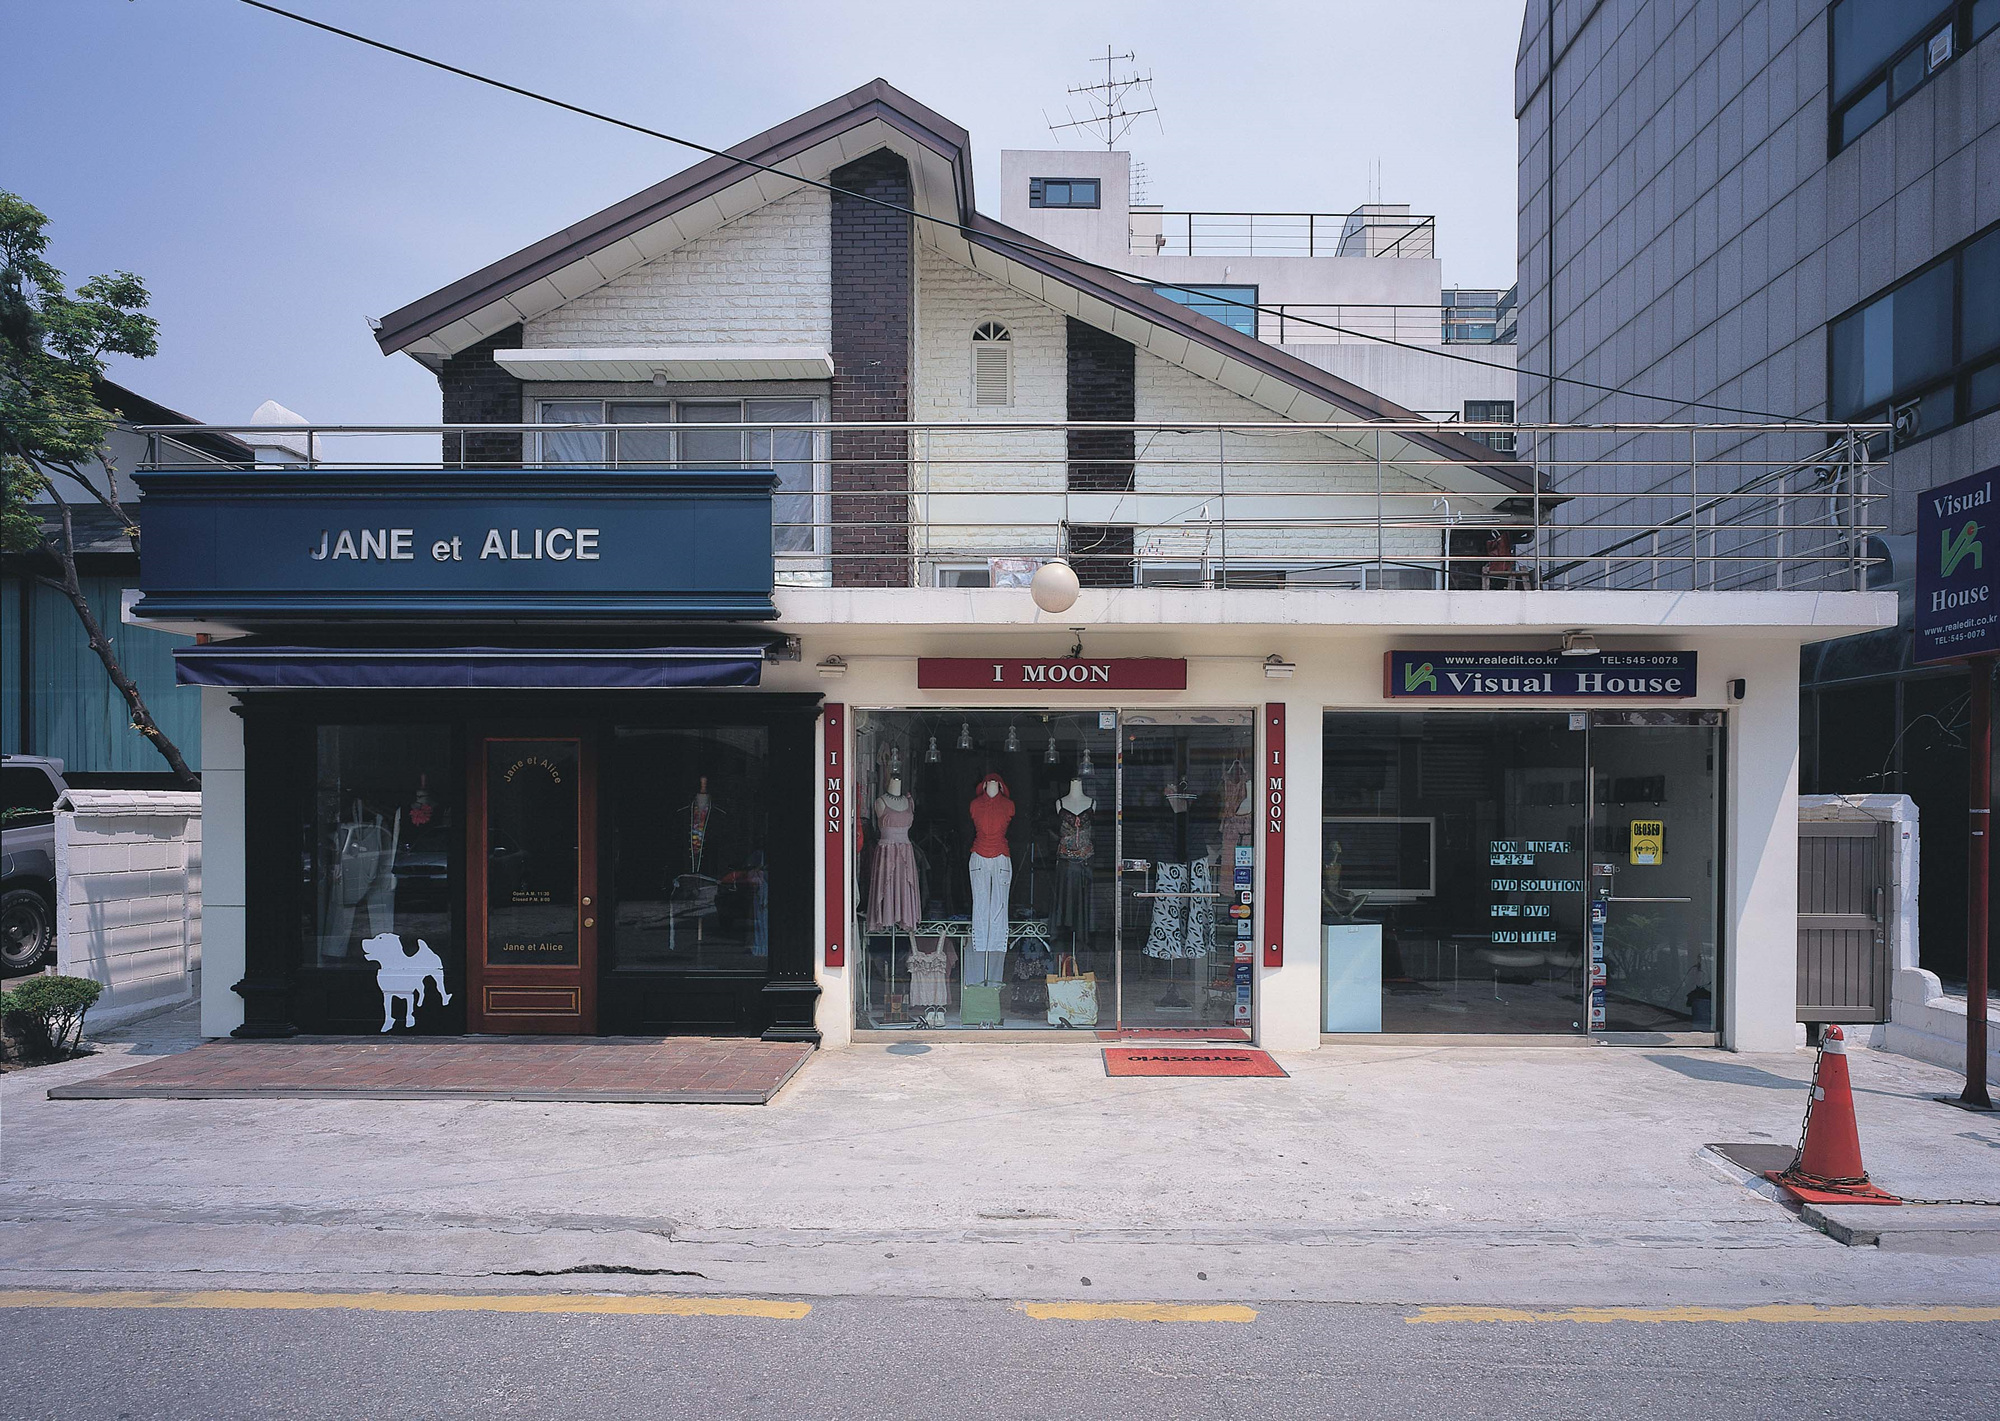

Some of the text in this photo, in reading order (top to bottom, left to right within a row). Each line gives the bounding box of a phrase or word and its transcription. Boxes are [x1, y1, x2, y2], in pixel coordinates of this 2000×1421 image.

[1933, 481, 1992, 519] Visual
[309, 528, 600, 561] JANE et ALICE
[1930, 585, 1990, 613] House
[1924, 613, 1998, 636] www.realedit.co.kr
[1934, 628, 1986, 646] TEL:545-0078
[1444, 655, 1559, 666] www.realedit.co.kr
[1600, 655, 1679, 666] TEL:545-0078
[992, 664, 1111, 682] I MOON
[1445, 672, 1682, 693] Visual House
[503, 756, 561, 784] Jane et Alice
[827, 751, 841, 833] I MOON
[1269, 751, 1283, 833] I MOON
[1491, 842, 1571, 853] NON LINEAR
[1491, 854, 1534, 865] 편집장비
[1492, 880, 1584, 892] DVD SOLUTION
[1524, 906, 1549, 917] DVD
[1492, 931, 1556, 943] DVD TITLE
[503, 943, 563, 951] Jane et Alice
